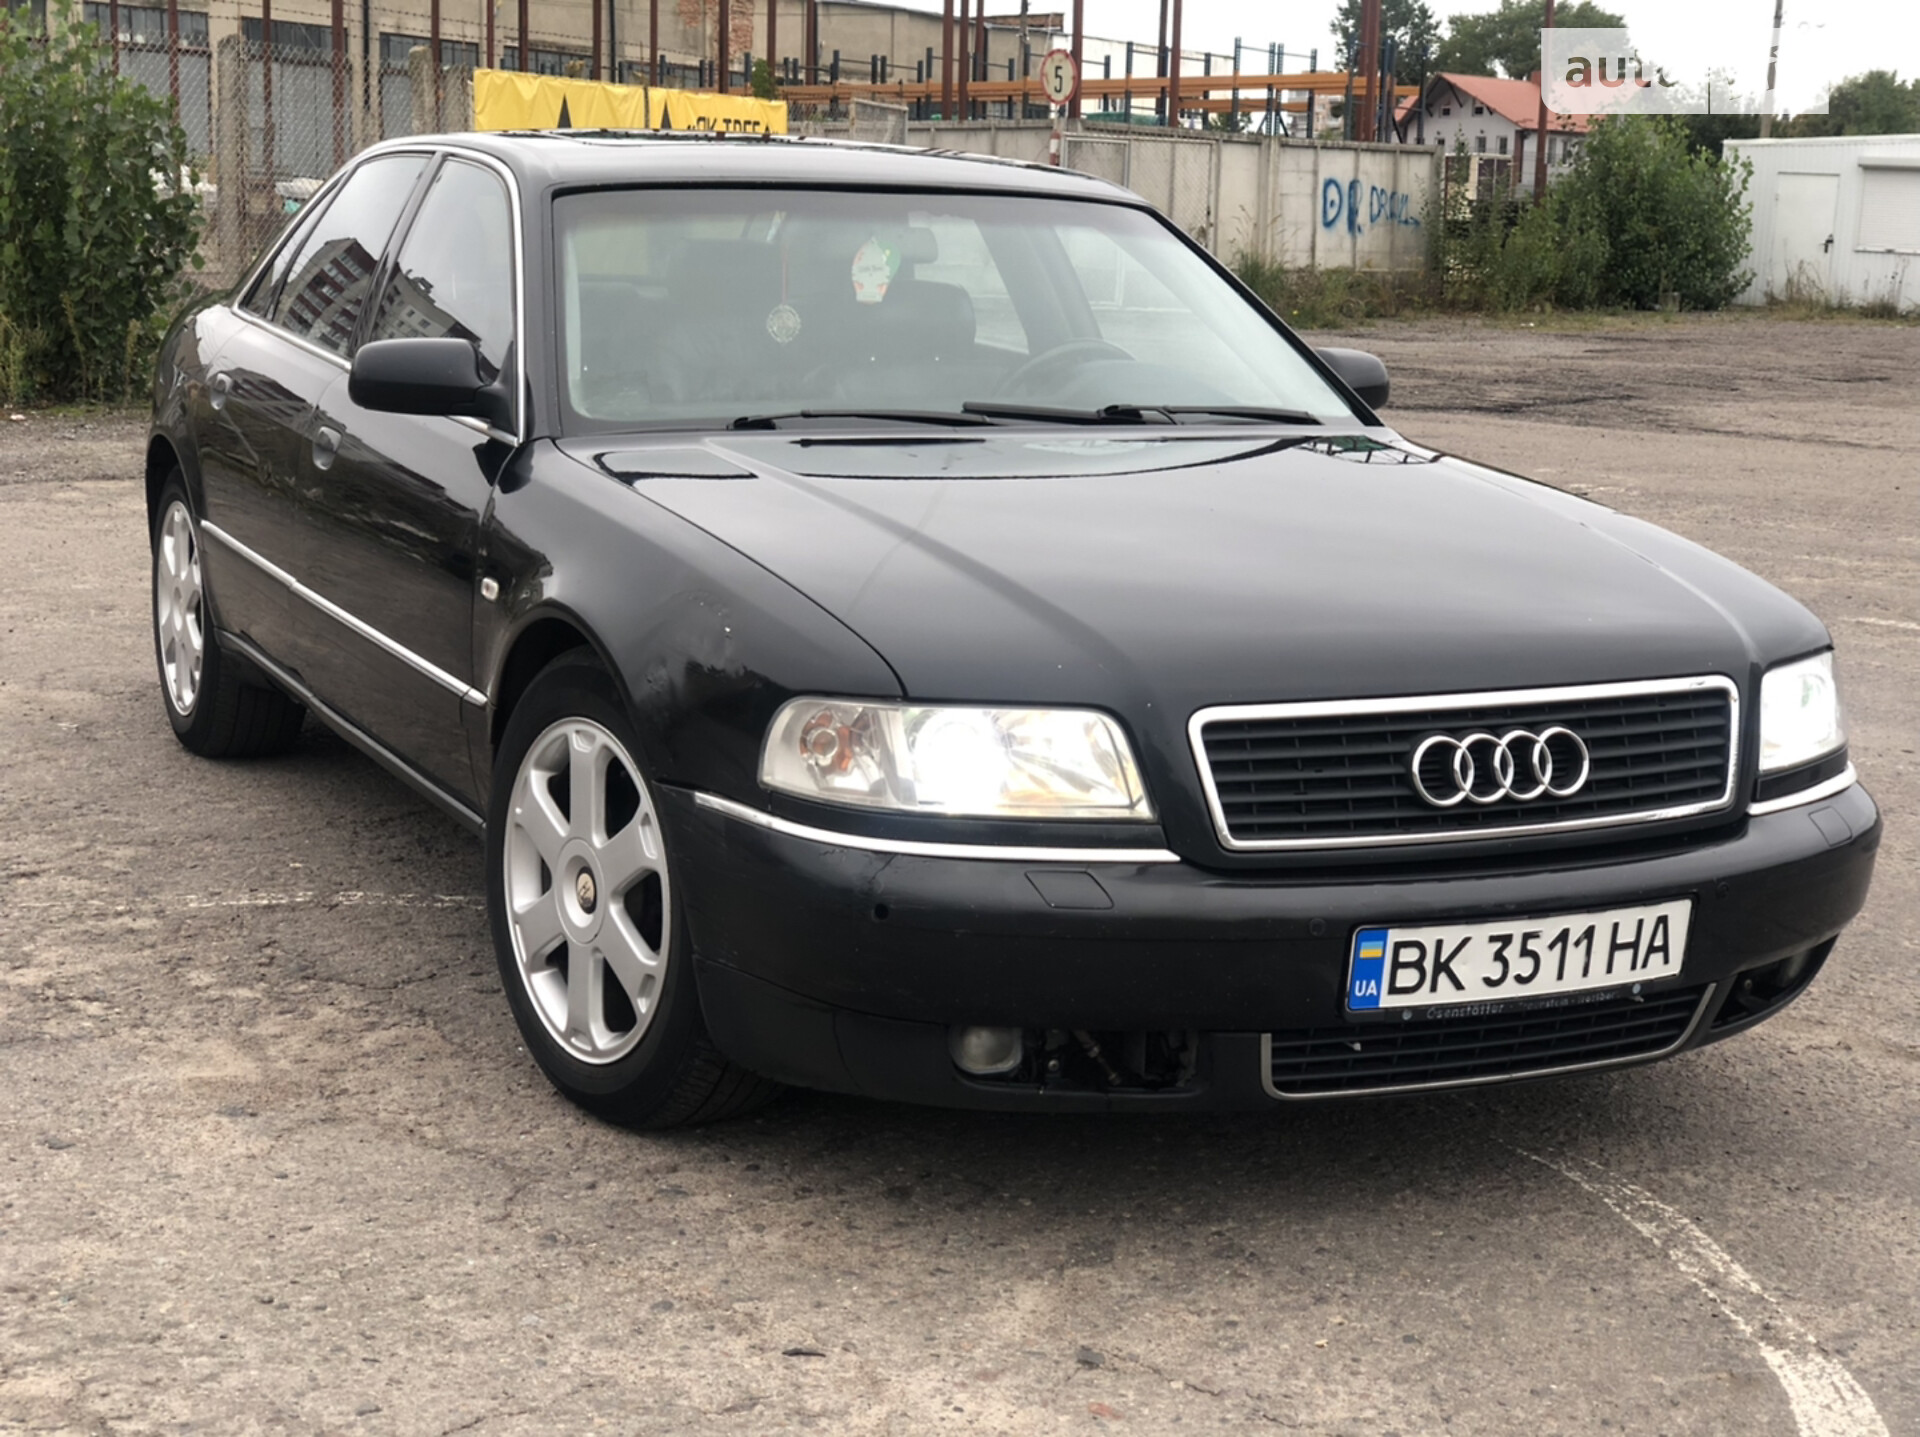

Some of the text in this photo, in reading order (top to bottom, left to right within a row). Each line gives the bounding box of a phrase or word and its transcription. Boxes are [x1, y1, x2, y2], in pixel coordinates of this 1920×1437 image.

[1054, 65, 1063, 93] 5
[1387, 914, 1670, 996] BK 3511 HA
[1355, 979, 1377, 997] UA
